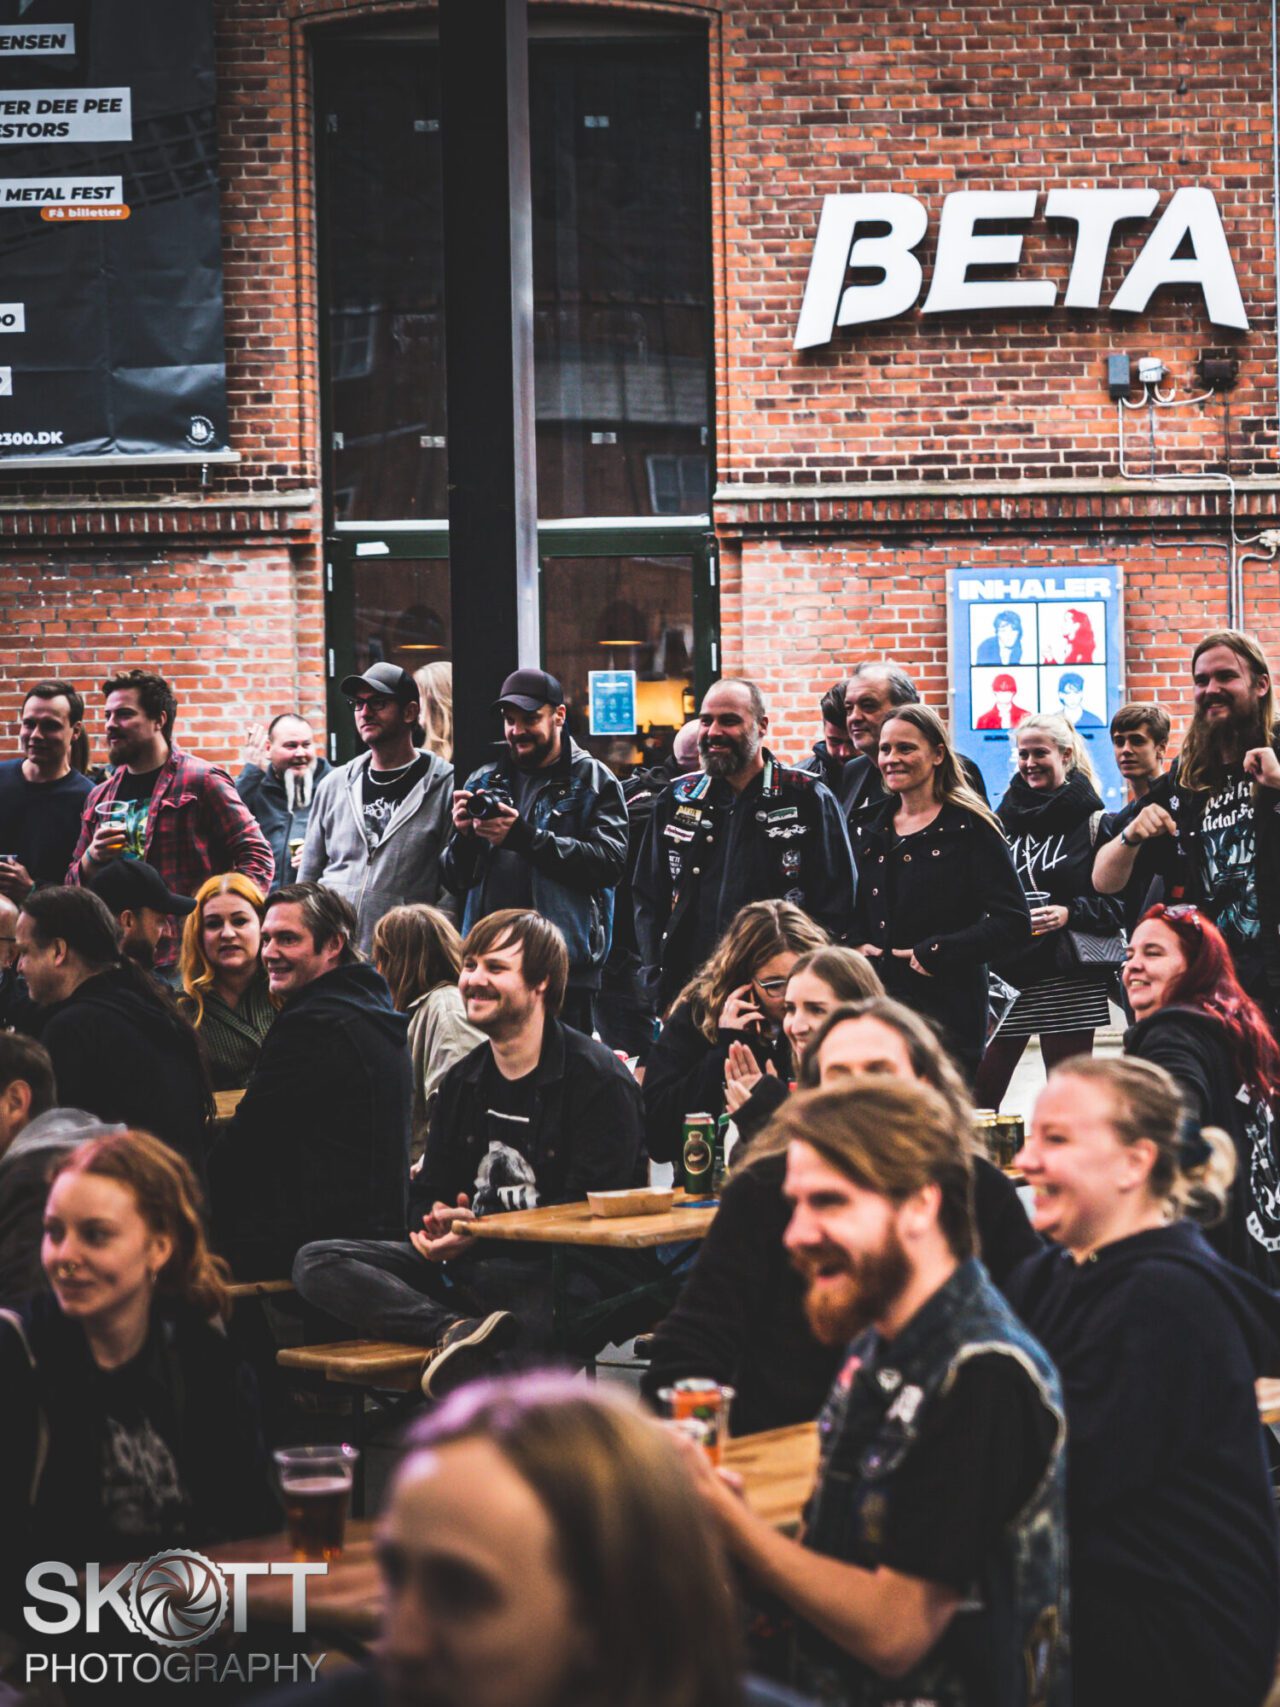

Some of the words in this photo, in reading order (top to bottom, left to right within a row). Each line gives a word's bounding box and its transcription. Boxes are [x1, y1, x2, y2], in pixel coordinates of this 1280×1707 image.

[36, 99, 79, 114] DEE
[83, 98, 123, 113] PEE
[0, 122, 69, 138] STORS
[5, 187, 65, 201] METAL
[71, 186, 115, 200] FEST
[48, 208, 65, 218] Få
[68, 207, 123, 217] billetter
[793, 187, 1249, 350] BETA
[958, 577, 1112, 600] INHALER
